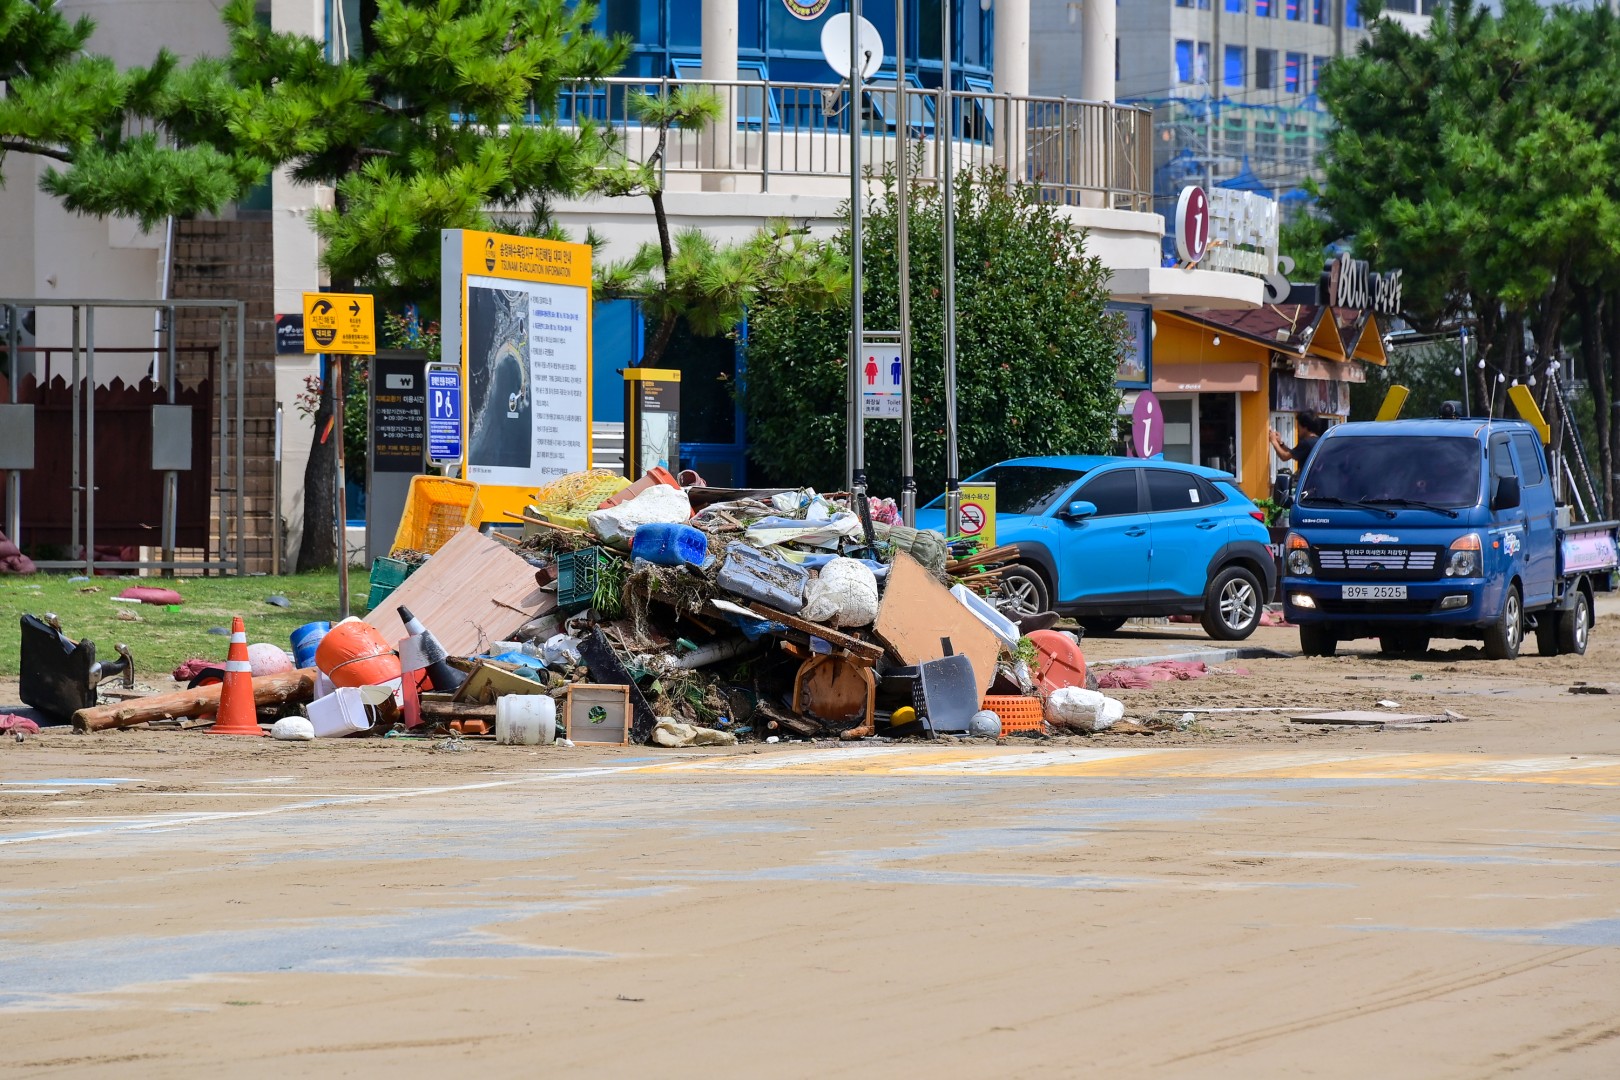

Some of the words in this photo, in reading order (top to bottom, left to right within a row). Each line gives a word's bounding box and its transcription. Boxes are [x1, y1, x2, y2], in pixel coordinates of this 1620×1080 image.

[501, 260, 519, 271] TSUNAMI
[519, 262, 545, 274] EVACUATION
[545, 266, 571, 277] INFORMATION
[312, 316, 336, 325] 지진해일
[435, 390, 443, 417] P
[1347, 587, 1369, 597] 89두
[1374, 587, 1402, 597] 2525
